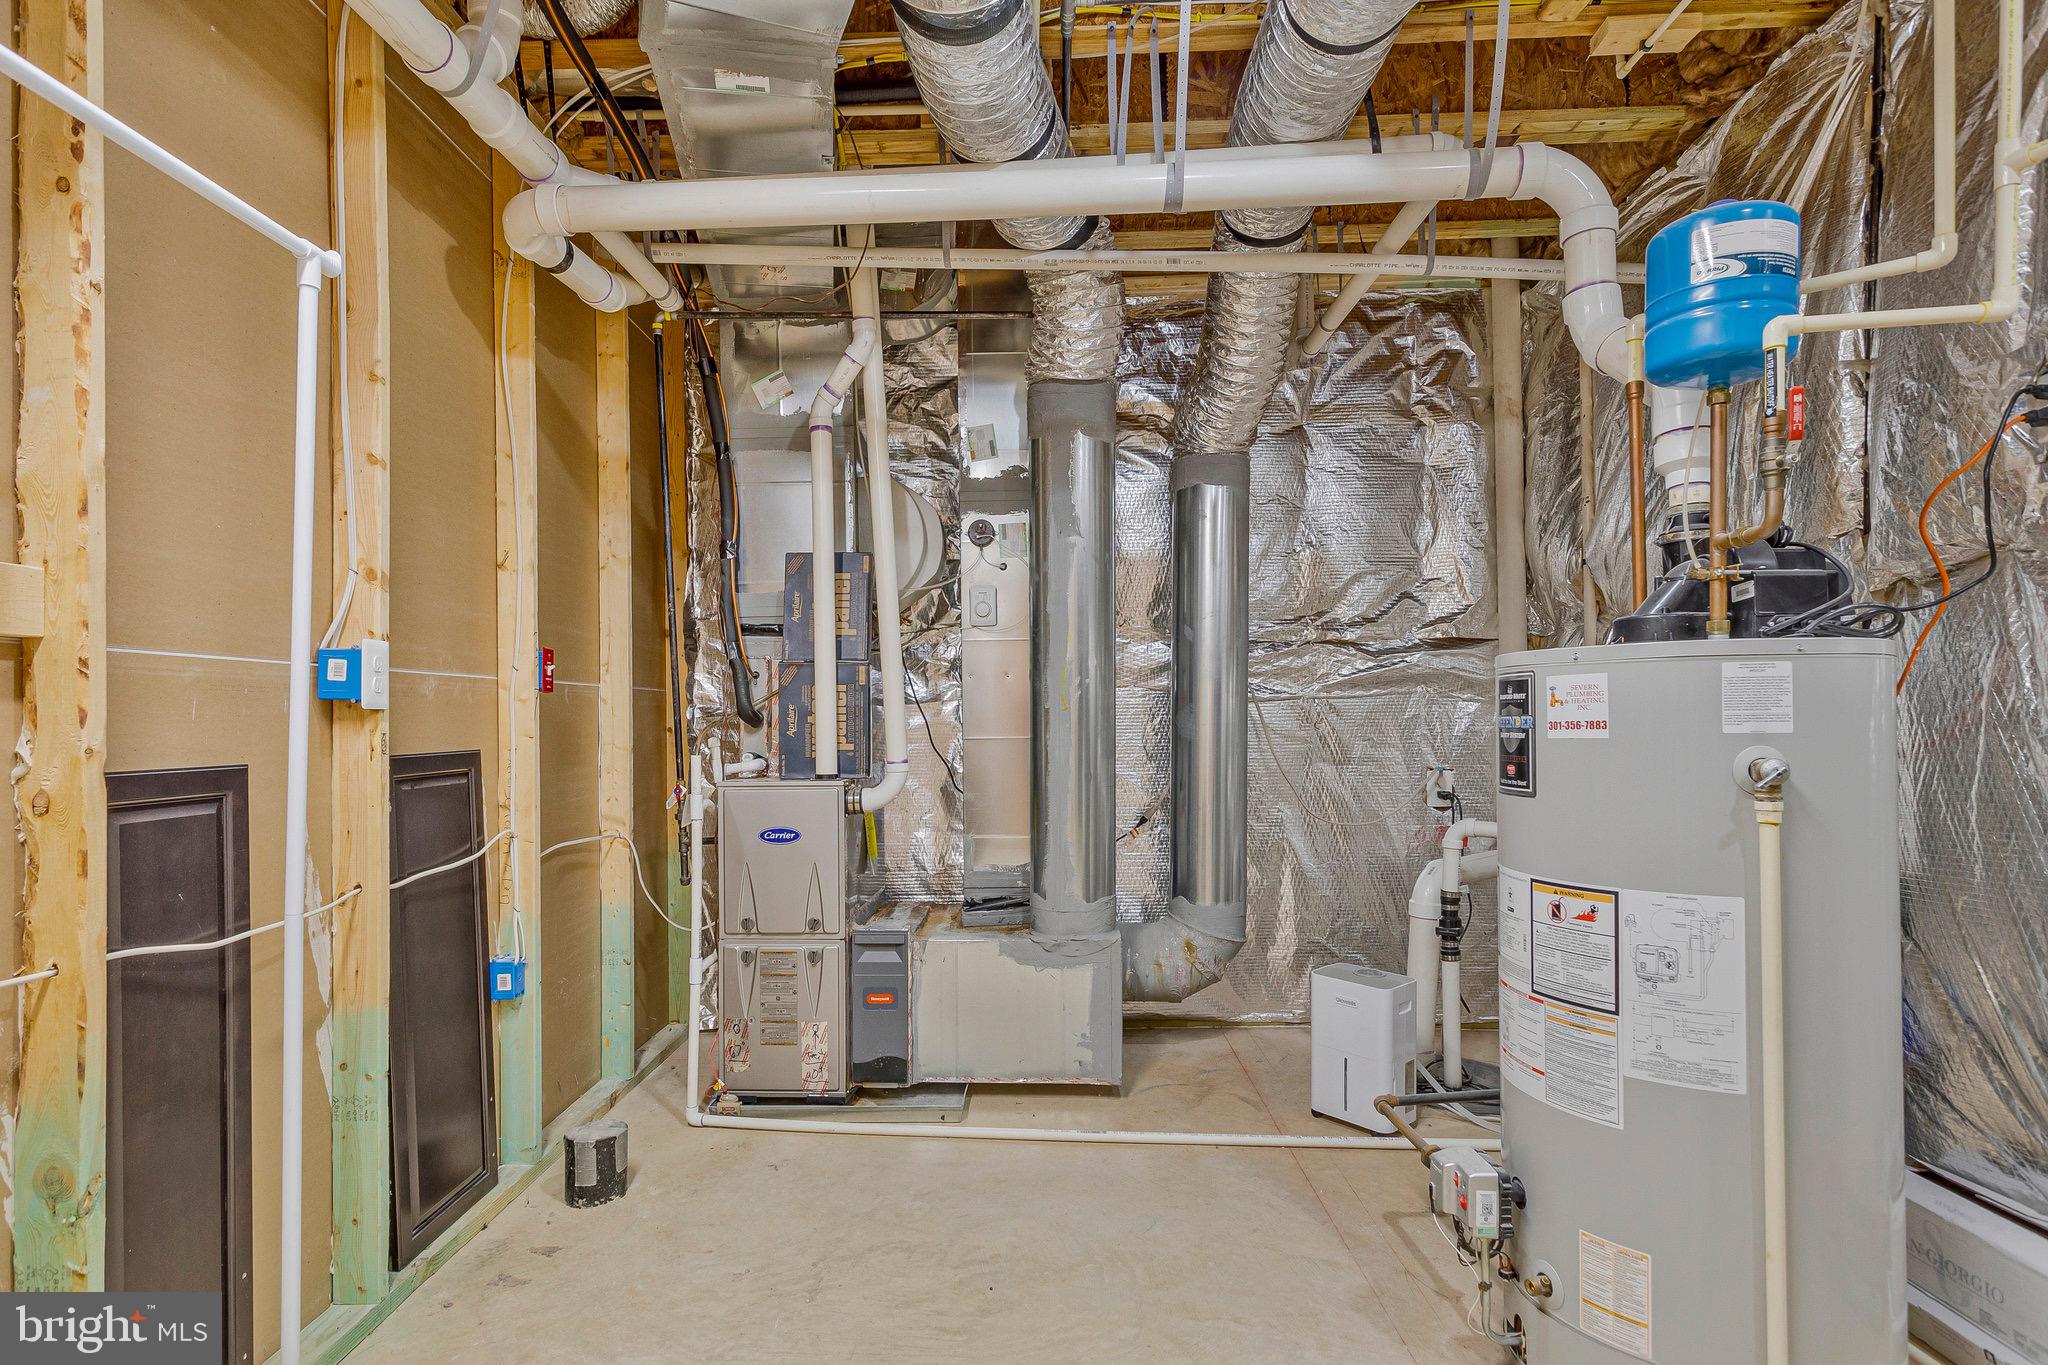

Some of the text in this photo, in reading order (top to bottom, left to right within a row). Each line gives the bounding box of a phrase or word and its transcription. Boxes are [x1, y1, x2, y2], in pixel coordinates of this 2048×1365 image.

[791, 591, 801, 623] Aprilaire
[1570, 683, 1599, 691] SEVERN
[1566, 690, 1605, 698] PLUMBING
[786, 703, 797, 738] Aprilaire
[1548, 720, 1607, 730] 301-356-7883
[764, 831, 796, 840] Carrier
[1559, 890, 1585, 899] WARNING
